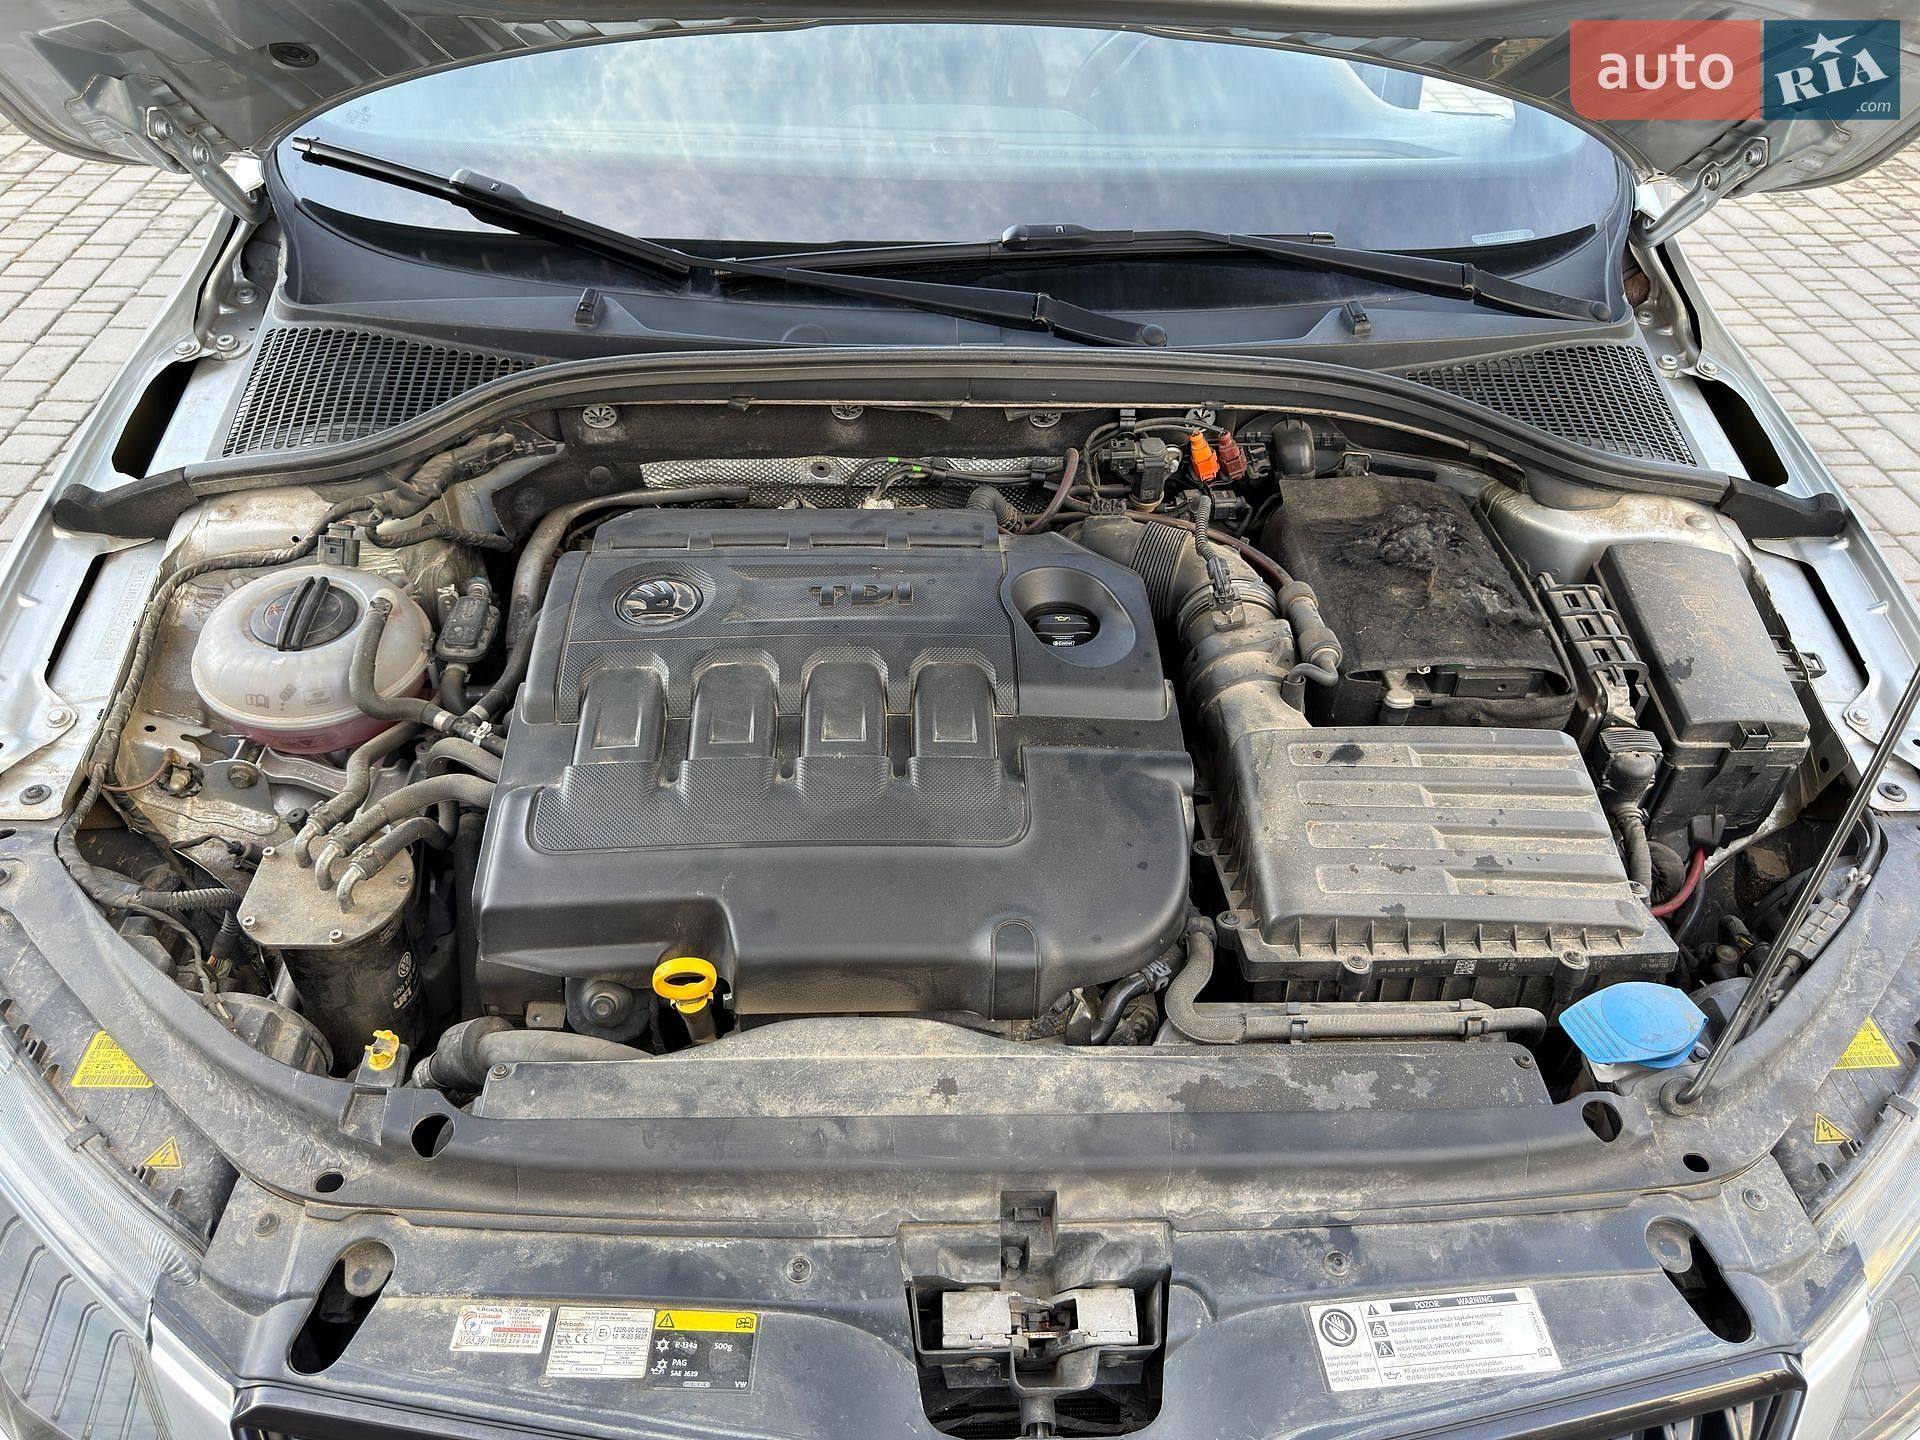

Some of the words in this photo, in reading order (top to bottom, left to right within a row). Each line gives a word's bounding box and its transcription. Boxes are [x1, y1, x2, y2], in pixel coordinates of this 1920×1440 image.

[808, 582, 914, 606] TDI
[1414, 1300, 1440, 1310] POZOR
[1456, 1295, 1493, 1306] WARNING
[713, 1342, 733, 1352] 500g
[672, 1359, 688, 1367] PAG
[734, 1380, 748, 1388] VW
